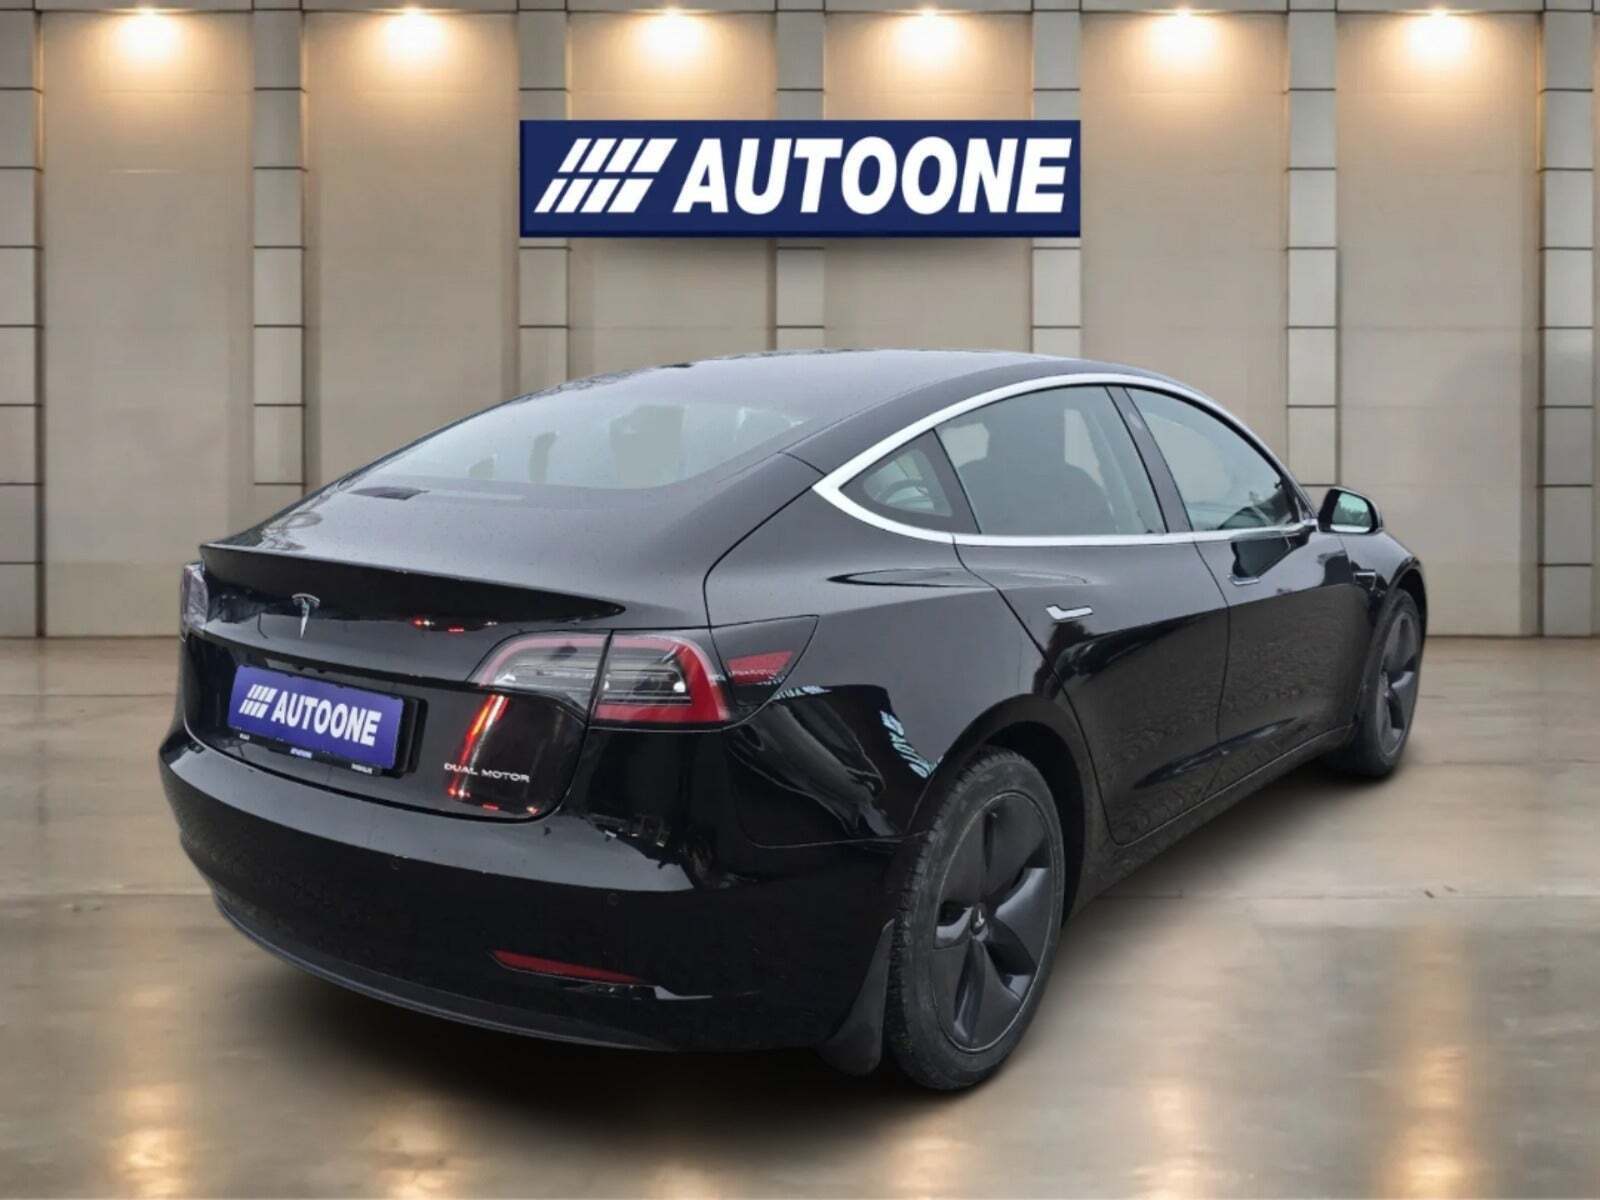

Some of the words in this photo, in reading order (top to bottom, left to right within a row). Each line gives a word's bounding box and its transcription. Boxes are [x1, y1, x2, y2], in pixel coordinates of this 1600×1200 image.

[672, 136, 1072, 215] AUTOONE
[271, 691, 382, 747] AUTOONE
[443, 762, 479, 776] DUAL
[481, 769, 530, 783] MOTOR
